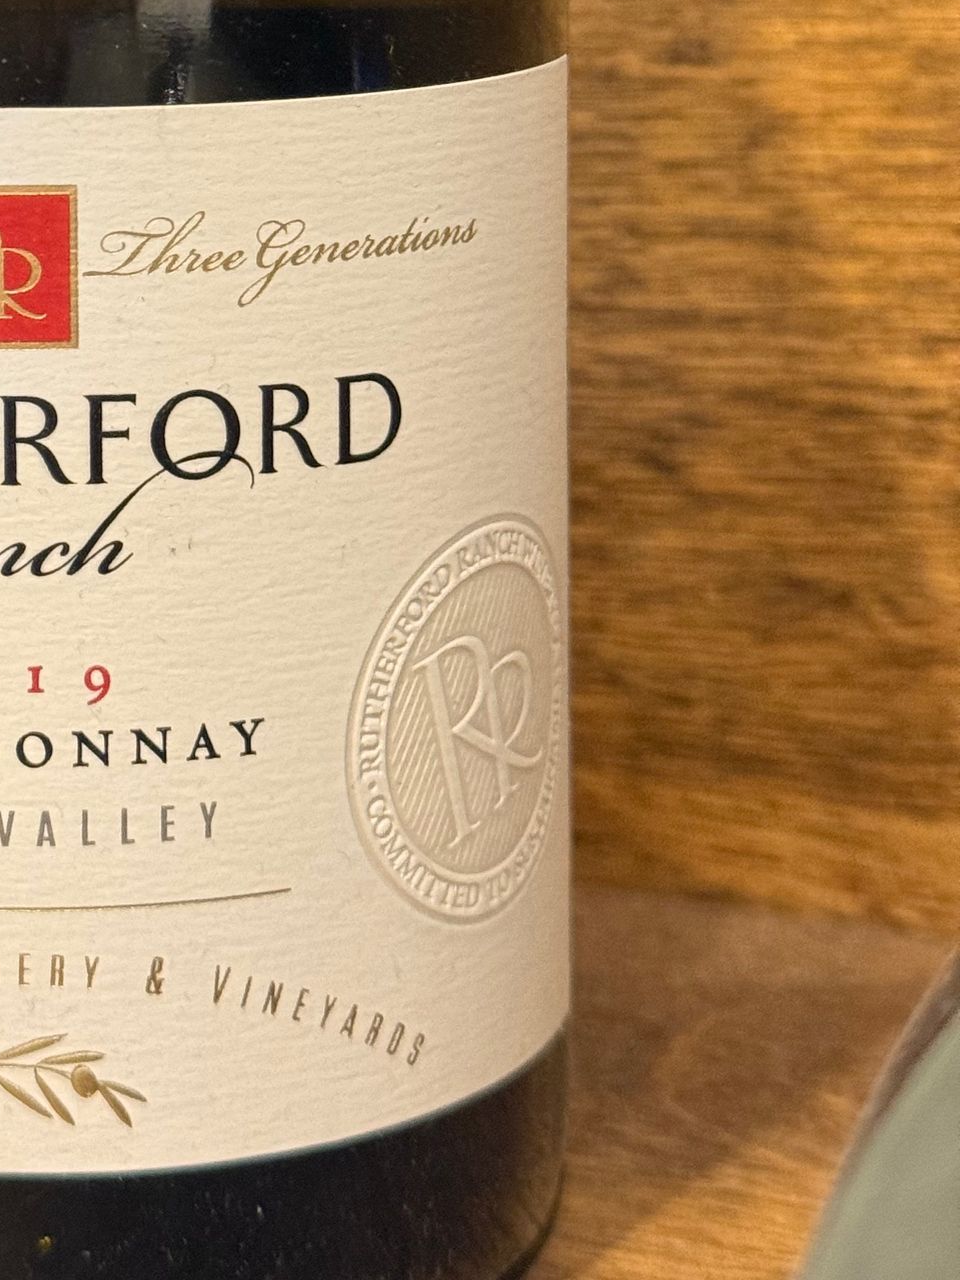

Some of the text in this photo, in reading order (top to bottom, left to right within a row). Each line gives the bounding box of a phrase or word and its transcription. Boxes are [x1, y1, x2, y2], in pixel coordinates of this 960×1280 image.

[82, 210, 478, 308] Three Generations
[144, 956, 166, 996] &
[212, 964, 427, 1067] VINEYARDS
